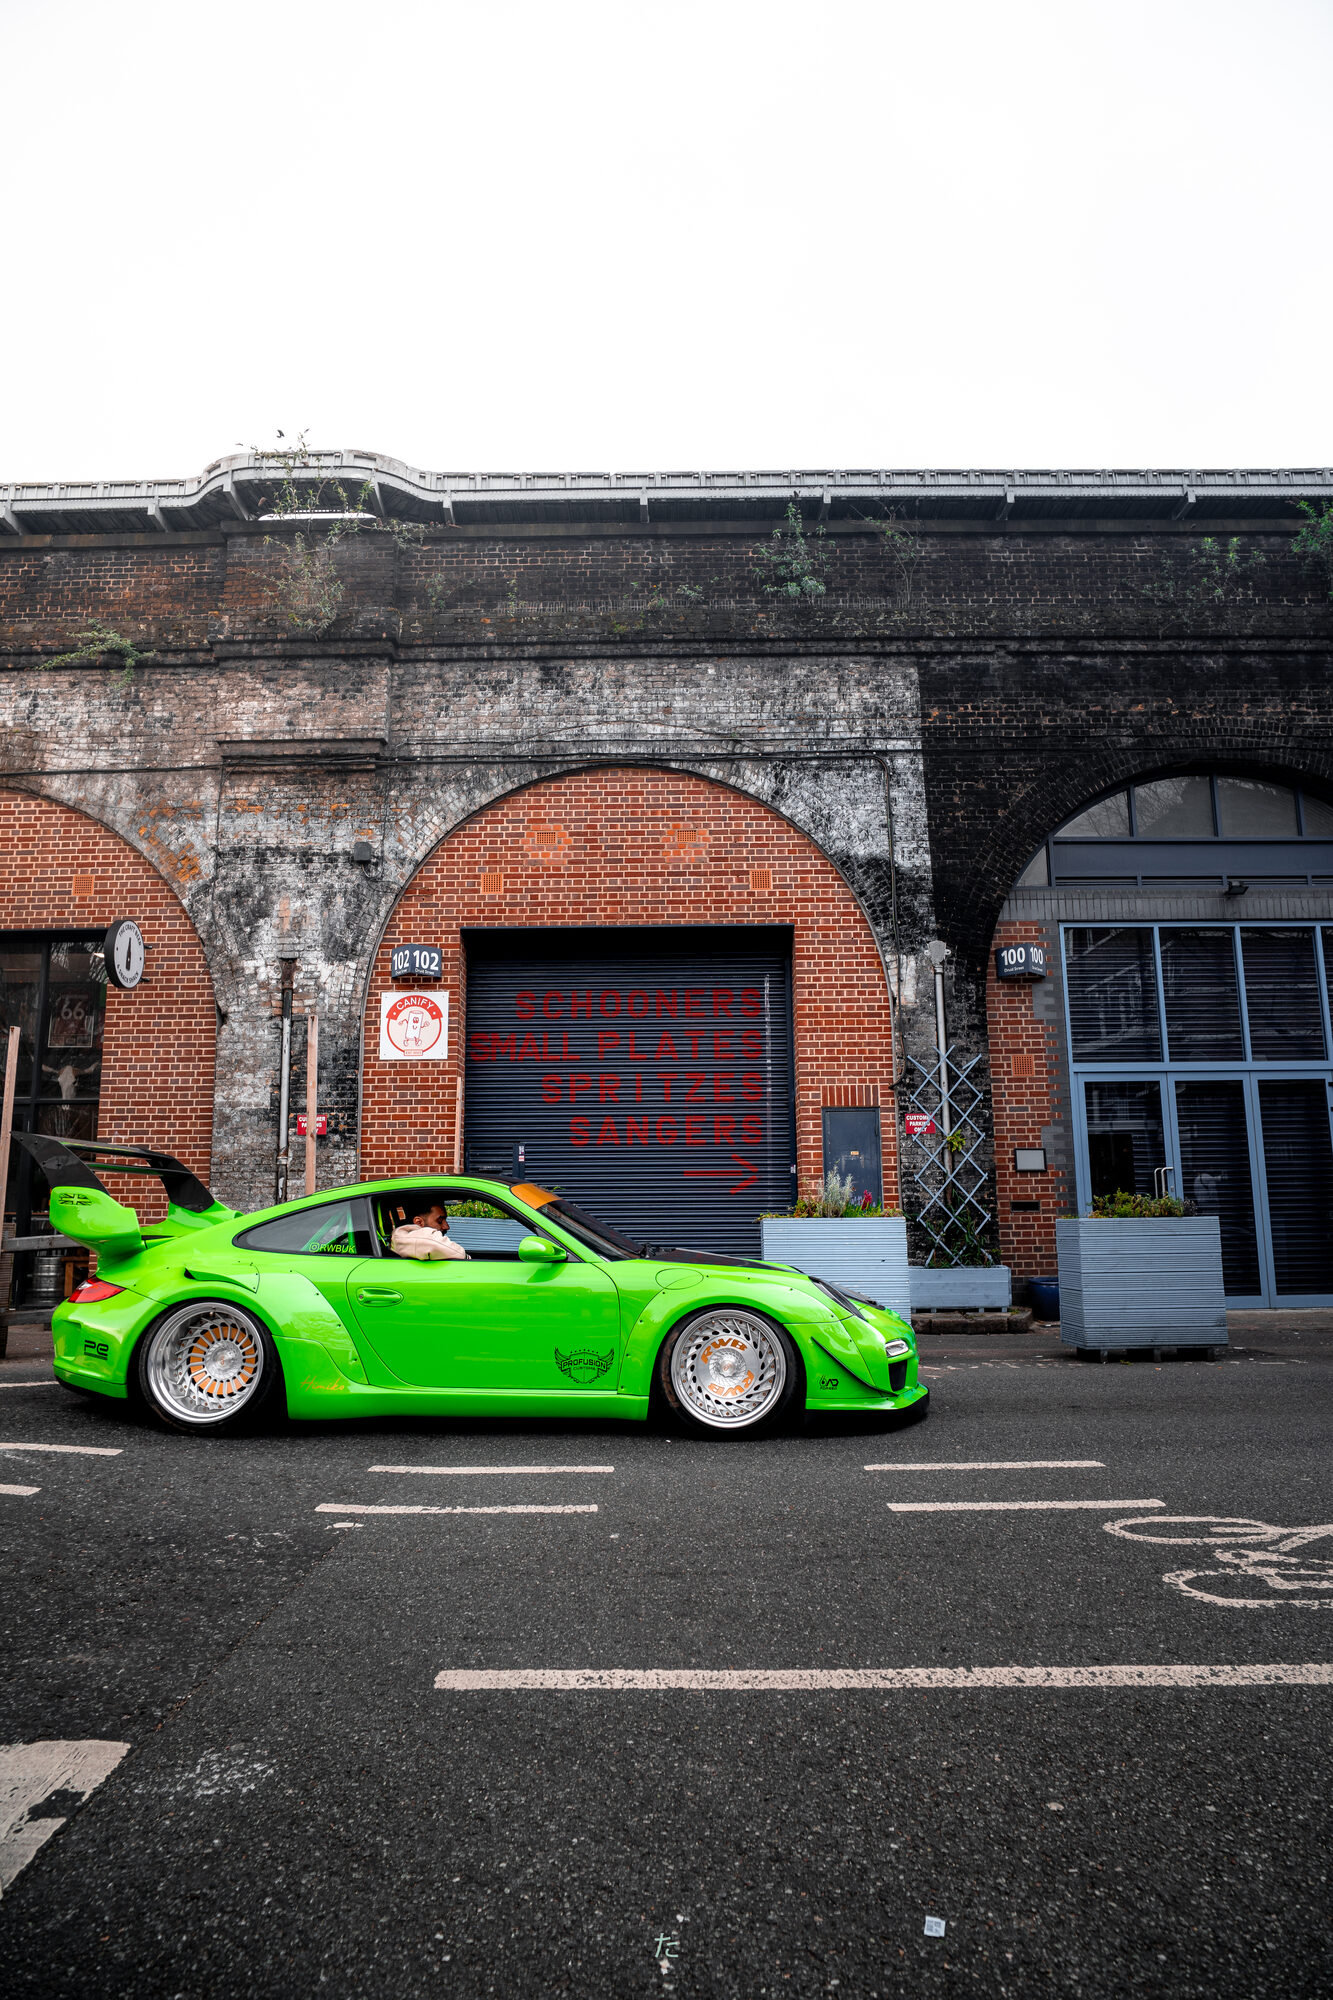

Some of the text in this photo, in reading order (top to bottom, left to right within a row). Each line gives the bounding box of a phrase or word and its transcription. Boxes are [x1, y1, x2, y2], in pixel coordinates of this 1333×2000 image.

[393, 950, 410, 970] 102
[413, 950, 438, 970] 102
[1001, 947, 1025, 965] 100
[1030, 947, 1043, 964] 100
[61, 1001, 85, 1020] 66
[396, 997, 434, 1010] CANIFY
[515, 988, 762, 1020] SCHOONERS
[469, 1030, 763, 1061] SMALL PLATES
[542, 1072, 763, 1104] SPRITZES
[569, 1115, 763, 1146] SANGERS
[701, 1338, 748, 1364] RWB
[562, 1359, 606, 1369] PROFUSION
[708, 1370, 754, 1396] RWB
